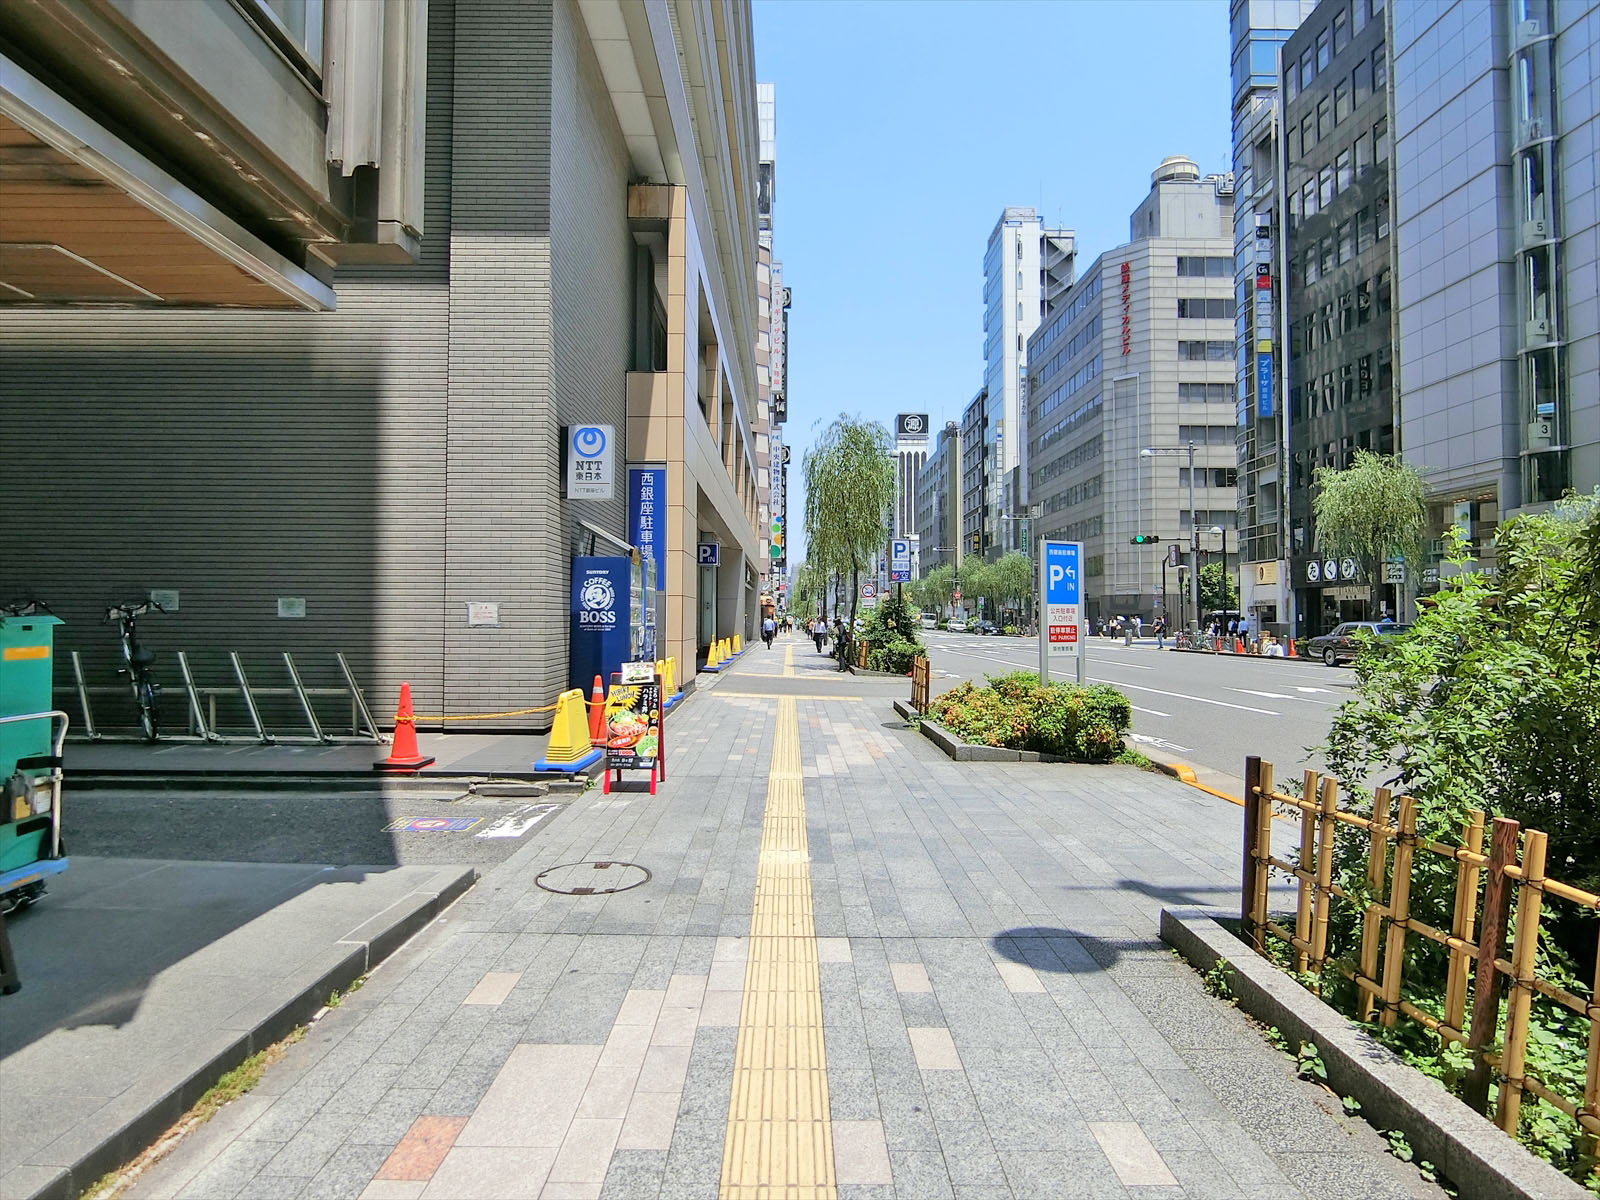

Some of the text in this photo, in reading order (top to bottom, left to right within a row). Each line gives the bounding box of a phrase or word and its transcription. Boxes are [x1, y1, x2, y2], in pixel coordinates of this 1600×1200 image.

[575, 461, 603, 471] NTT
[575, 472, 603, 481] 東日本
[772, 446, 780, 505] 中央建物株式会社
[639, 472, 654, 563] 西銀座駐車場
[699, 546, 711, 562] P
[894, 542, 906, 559] P
[584, 577, 612, 588] COFFEE
[1050, 565, 1064, 591] P
[1067, 582, 1075, 591] IN
[579, 611, 616, 623] BOSS
